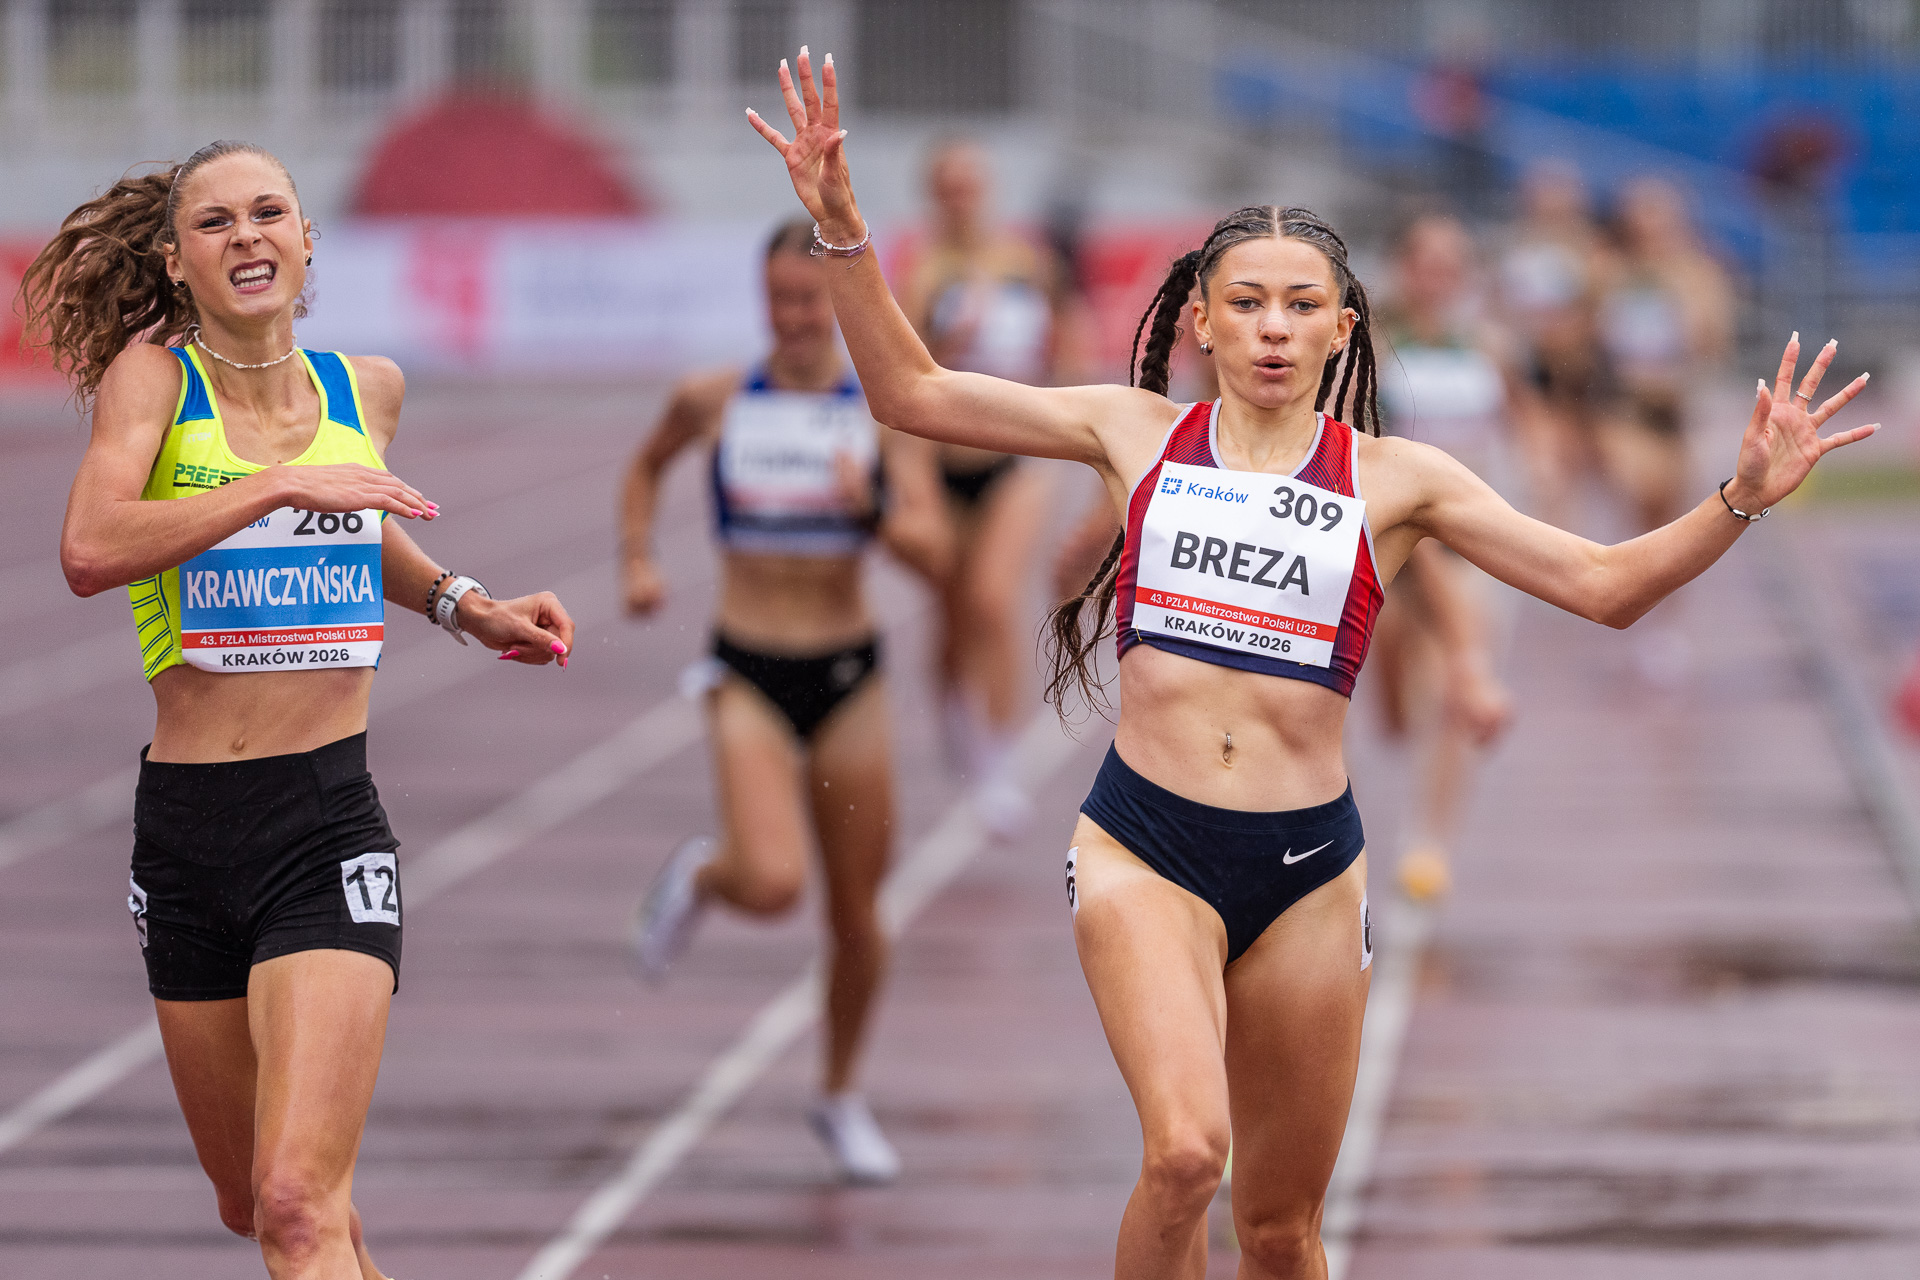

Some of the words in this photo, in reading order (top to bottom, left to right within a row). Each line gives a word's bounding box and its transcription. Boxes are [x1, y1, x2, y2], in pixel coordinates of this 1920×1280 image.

[173, 462, 243, 486] PREF
[1187, 482, 1249, 504] Kraków
[293, 508, 363, 536] 266
[1269, 486, 1343, 532] 309
[1170, 531, 1310, 596] BREZA
[186, 557, 375, 609] KRAWCZYŃSKA
[1150, 592, 1164, 606] 43.
[1166, 596, 1190, 610] PZLA
[1192, 602, 1260, 625] Mistrzostwa
[1262, 616, 1294, 631] Polski
[1296, 622, 1318, 636] U23
[200, 635, 218, 647] 43.
[220, 634, 246, 646] PZLA
[248, 631, 314, 645] Mistrzostwa
[316, 629, 346, 642] Polski
[348, 628, 368, 640] U23
[1164, 615, 1245, 643] KRAKÓW
[1248, 633, 1292, 653] 2026
[222, 648, 303, 667] KRAKÓW
[308, 648, 350, 664] 2026
[346, 865, 397, 913] 12
